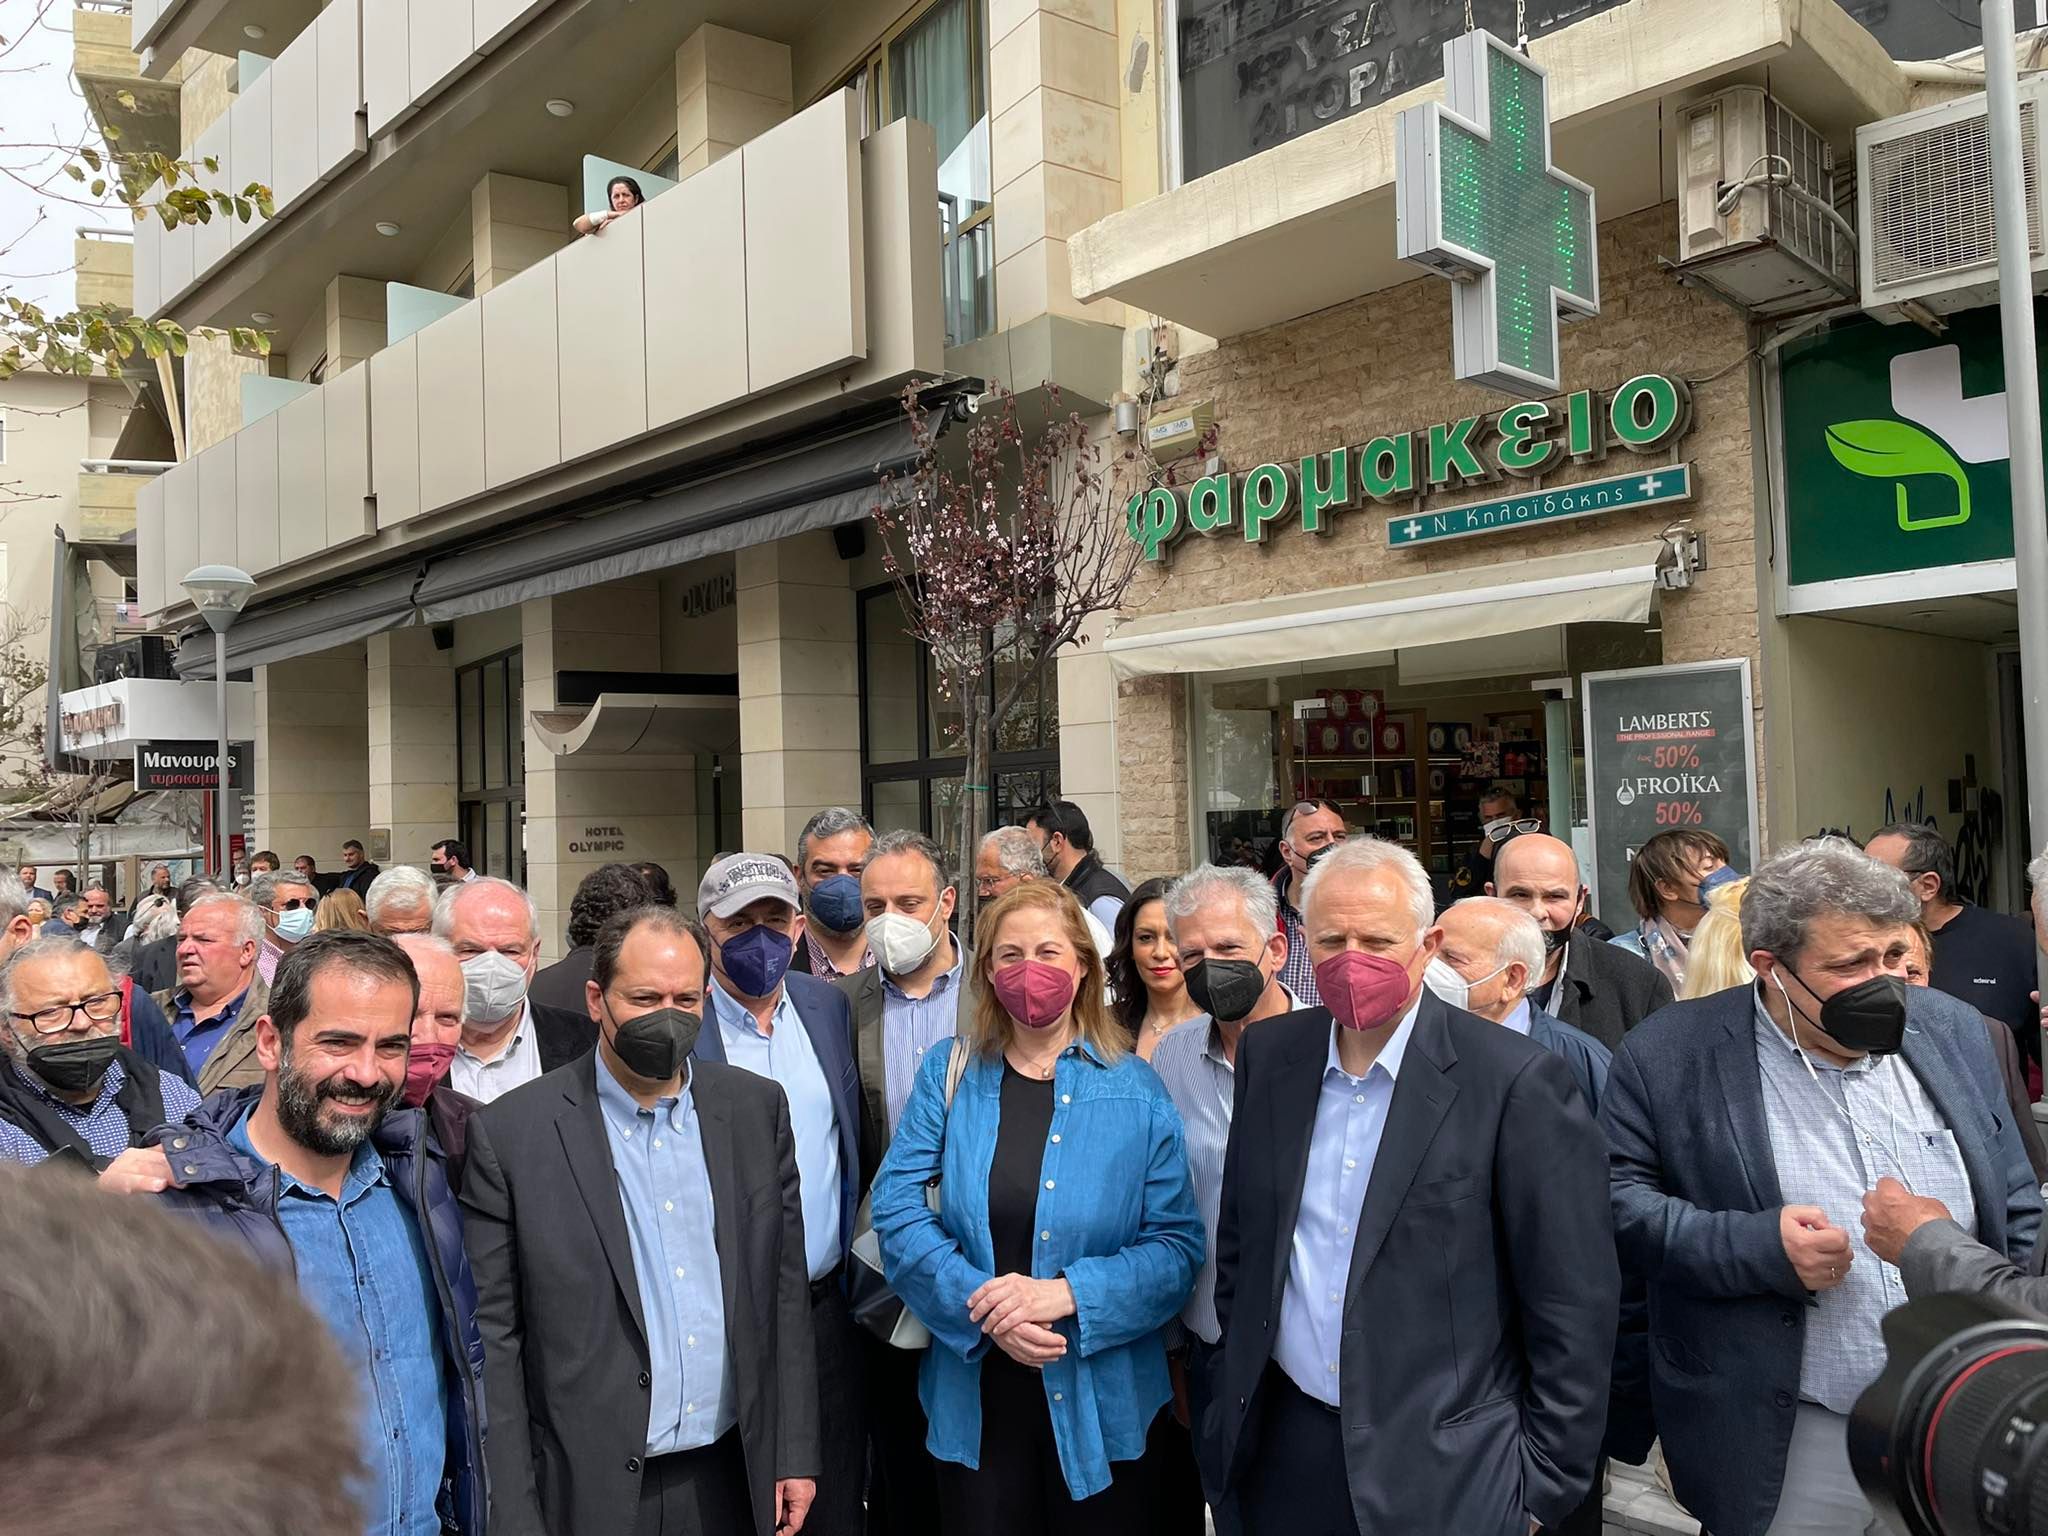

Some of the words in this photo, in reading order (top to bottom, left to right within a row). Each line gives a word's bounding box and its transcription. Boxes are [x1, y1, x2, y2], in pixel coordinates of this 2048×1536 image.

[1466, 487, 1624, 528] Κηλαϊδάκης
[1619, 711, 1711, 732] LAMBERTS
[1620, 733, 1633, 741] THE
[1634, 731, 1683, 740] PROFESSIONAL
[1686, 729, 1711, 738] RANGE
[1654, 743, 1700, 768] 50%
[1636, 773, 1722, 795] FROÏKA
[1655, 801, 1702, 824] 50%
[585, 826, 624, 837] HOTEL
[568, 840, 624, 853] OLYMPIC
